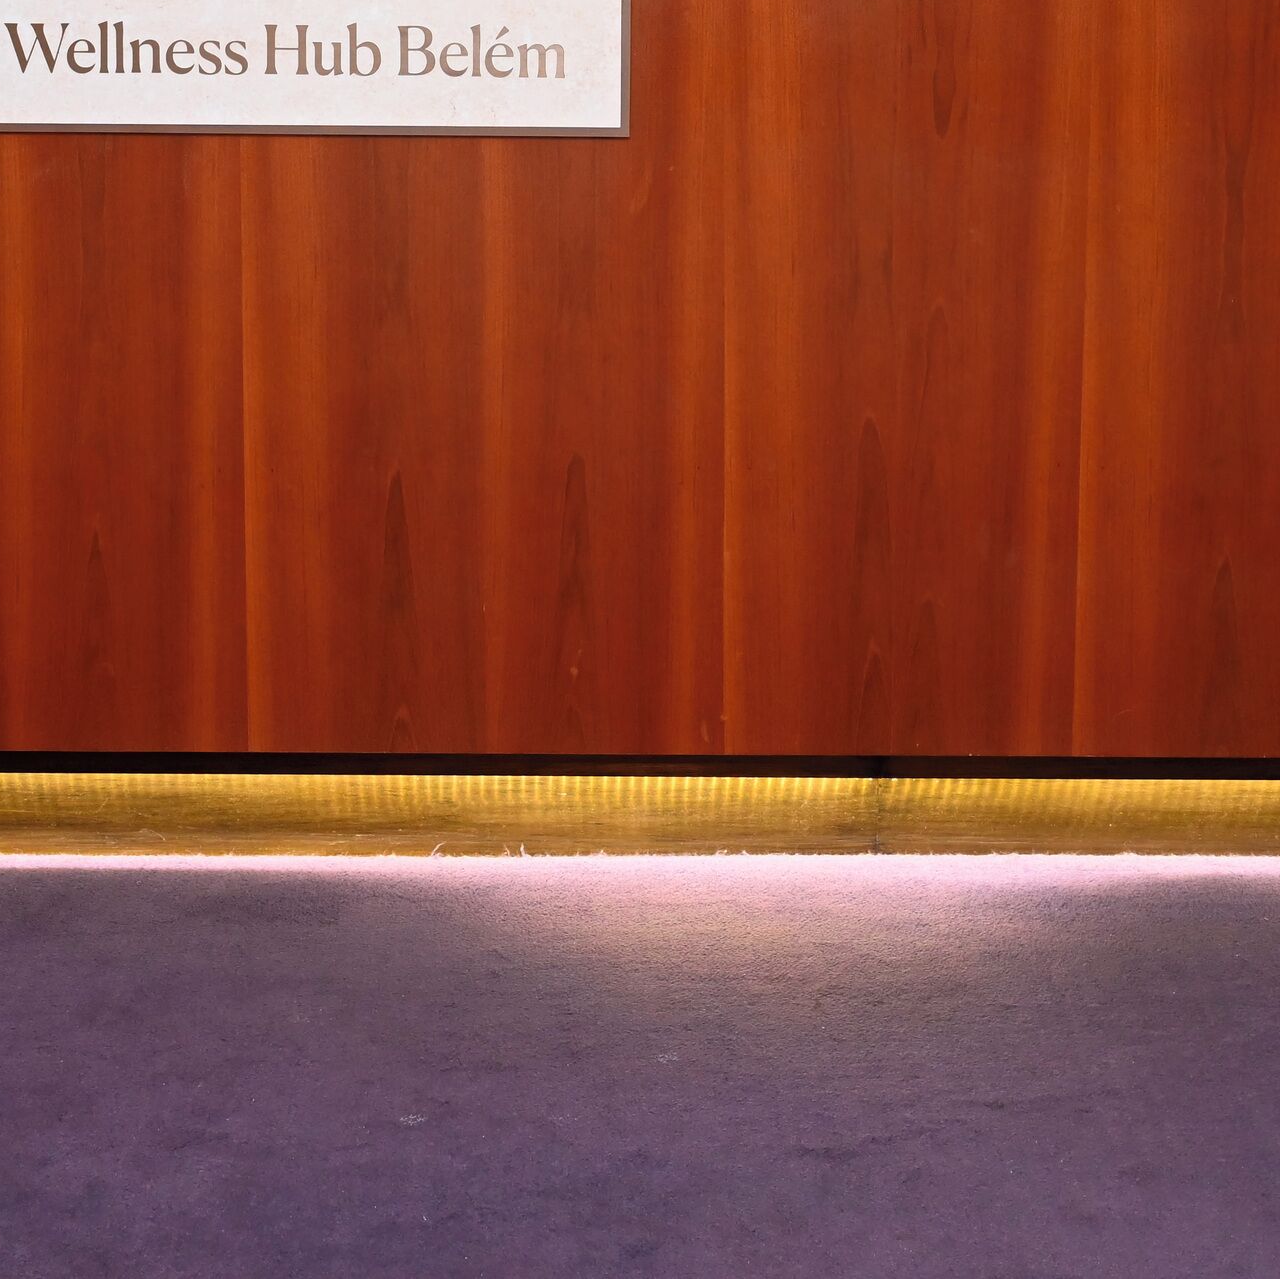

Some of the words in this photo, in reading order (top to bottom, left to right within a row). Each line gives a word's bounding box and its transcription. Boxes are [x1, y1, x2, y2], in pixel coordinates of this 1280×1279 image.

[4, 20, 249, 76] Wellness
[263, 22, 382, 77] Hub
[397, 23, 567, 79] Belém
